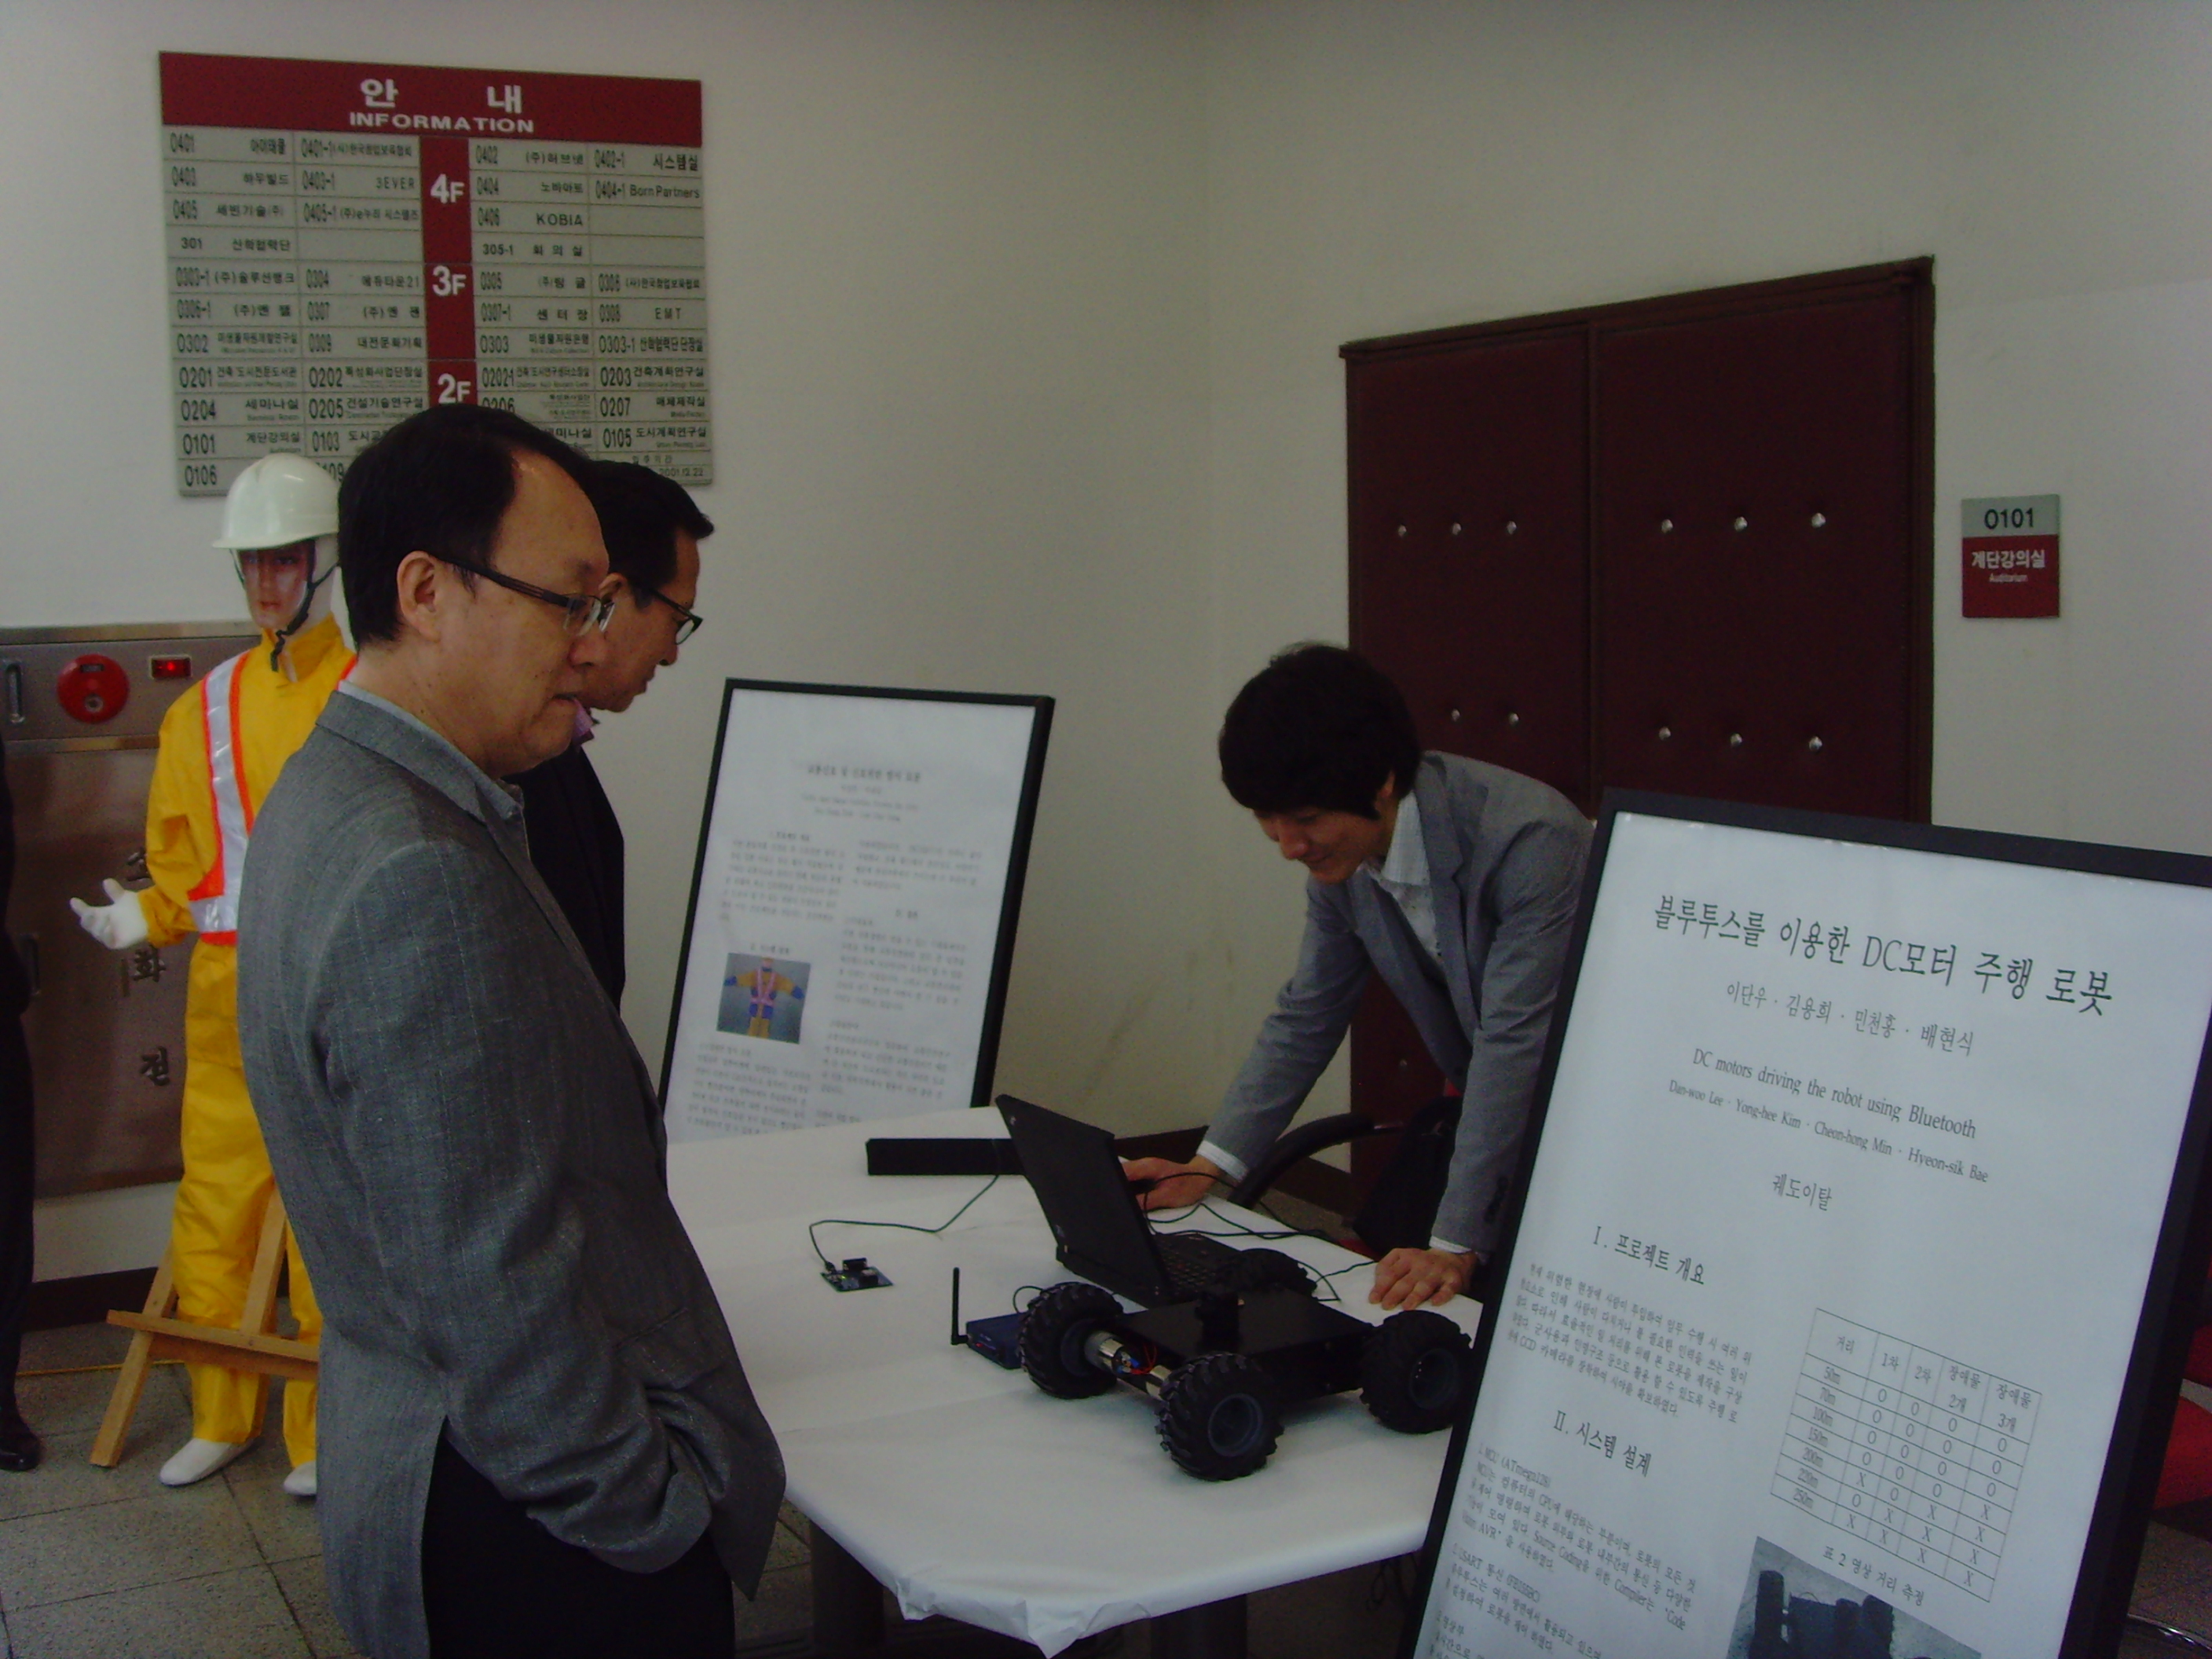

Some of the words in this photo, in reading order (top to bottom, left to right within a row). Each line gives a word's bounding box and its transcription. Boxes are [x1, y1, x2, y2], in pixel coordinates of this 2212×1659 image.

[350, 112, 534, 133] INFORMATION
[652, 156, 698, 171] 시스템실
[430, 173, 465, 203] 4F
[537, 213, 583, 226] KOBIA
[181, 237, 203, 249] 301
[482, 244, 513, 256] 305-1
[432, 266, 467, 296] 3F
[178, 333, 208, 353] 0302
[480, 335, 509, 353] 0303
[599, 335, 635, 353] 0303-1
[179, 366, 213, 388] 0201
[309, 366, 343, 387] 0202
[600, 367, 632, 387] 0203
[633, 367, 704, 378] 건축계획연구실
[438, 373, 471, 404] 2F
[181, 399, 216, 421] 0204
[245, 399, 298, 410] 세미나실
[309, 398, 343, 419] 0205
[346, 397, 423, 408] 건설기술연구실
[600, 397, 630, 417] 0207
[182, 433, 215, 454] 0101
[246, 432, 300, 444] 계단강의실
[312, 431, 339, 452] 0103
[602, 428, 632, 449] 0105
[636, 427, 706, 438] 도시계획연구실
[184, 464, 217, 486] 0106
[1984, 507, 2034, 529] 0101
[1972, 550, 2046, 569] 계단강의실
[1655, 895, 1765, 947] 블루투스를
[1780, 917, 1850, 964] 이용한
[1862, 936, 1957, 986] DC모터
[1974, 951, 2033, 999] 주행
[2045, 969, 2112, 1016] 로봇
[1727, 981, 1767, 1008] 이단우
[1786, 994, 1832, 1024] 김용희
[1855, 1009, 1895, 1039] 민천홍
[1921, 1024, 1973, 1057] 배현식
[1693, 1049, 1712, 1068] DC
[1716, 1057, 1752, 1079] motors
[1758, 1066, 1802, 1095] driving
[1807, 1079, 1826, 1098] the
[1831, 1089, 1863, 1109] robot
[1867, 1099, 1901, 1122] using
[1908, 1104, 1976, 1138] Bluetooth
[1708, 1090, 1724, 1107] Lee
[1735, 1099, 1778, 1122] Yong-hee
[1781, 1111, 1801, 1129] Kim
[1814, 1121, 1868, 1151] Cheon-hong
[1872, 1137, 1892, 1155] Min
[1908, 1148, 1964, 1177] Hyeon-sik
[1969, 1164, 1988, 1183] Bae
[1772, 1174, 1833, 1211] 궤도이탈
[1614, 1234, 1670, 1270] 프로젝트
[1675, 1258, 1705, 1284] 개요
[1914, 1365, 1932, 1383] 2차
[1949, 1364, 1981, 1390] 장애물
[1996, 1384, 2031, 1409] 장애물
[1576, 1423, 1617, 1459] 시스템
[1623, 1445, 1652, 1477] 설계
[1839, 1554, 1846, 1567] 2
[1852, 1558, 1872, 1580] 영상
[1876, 1572, 1897, 1591] 거리
[1903, 1584, 1925, 1606] 측정
